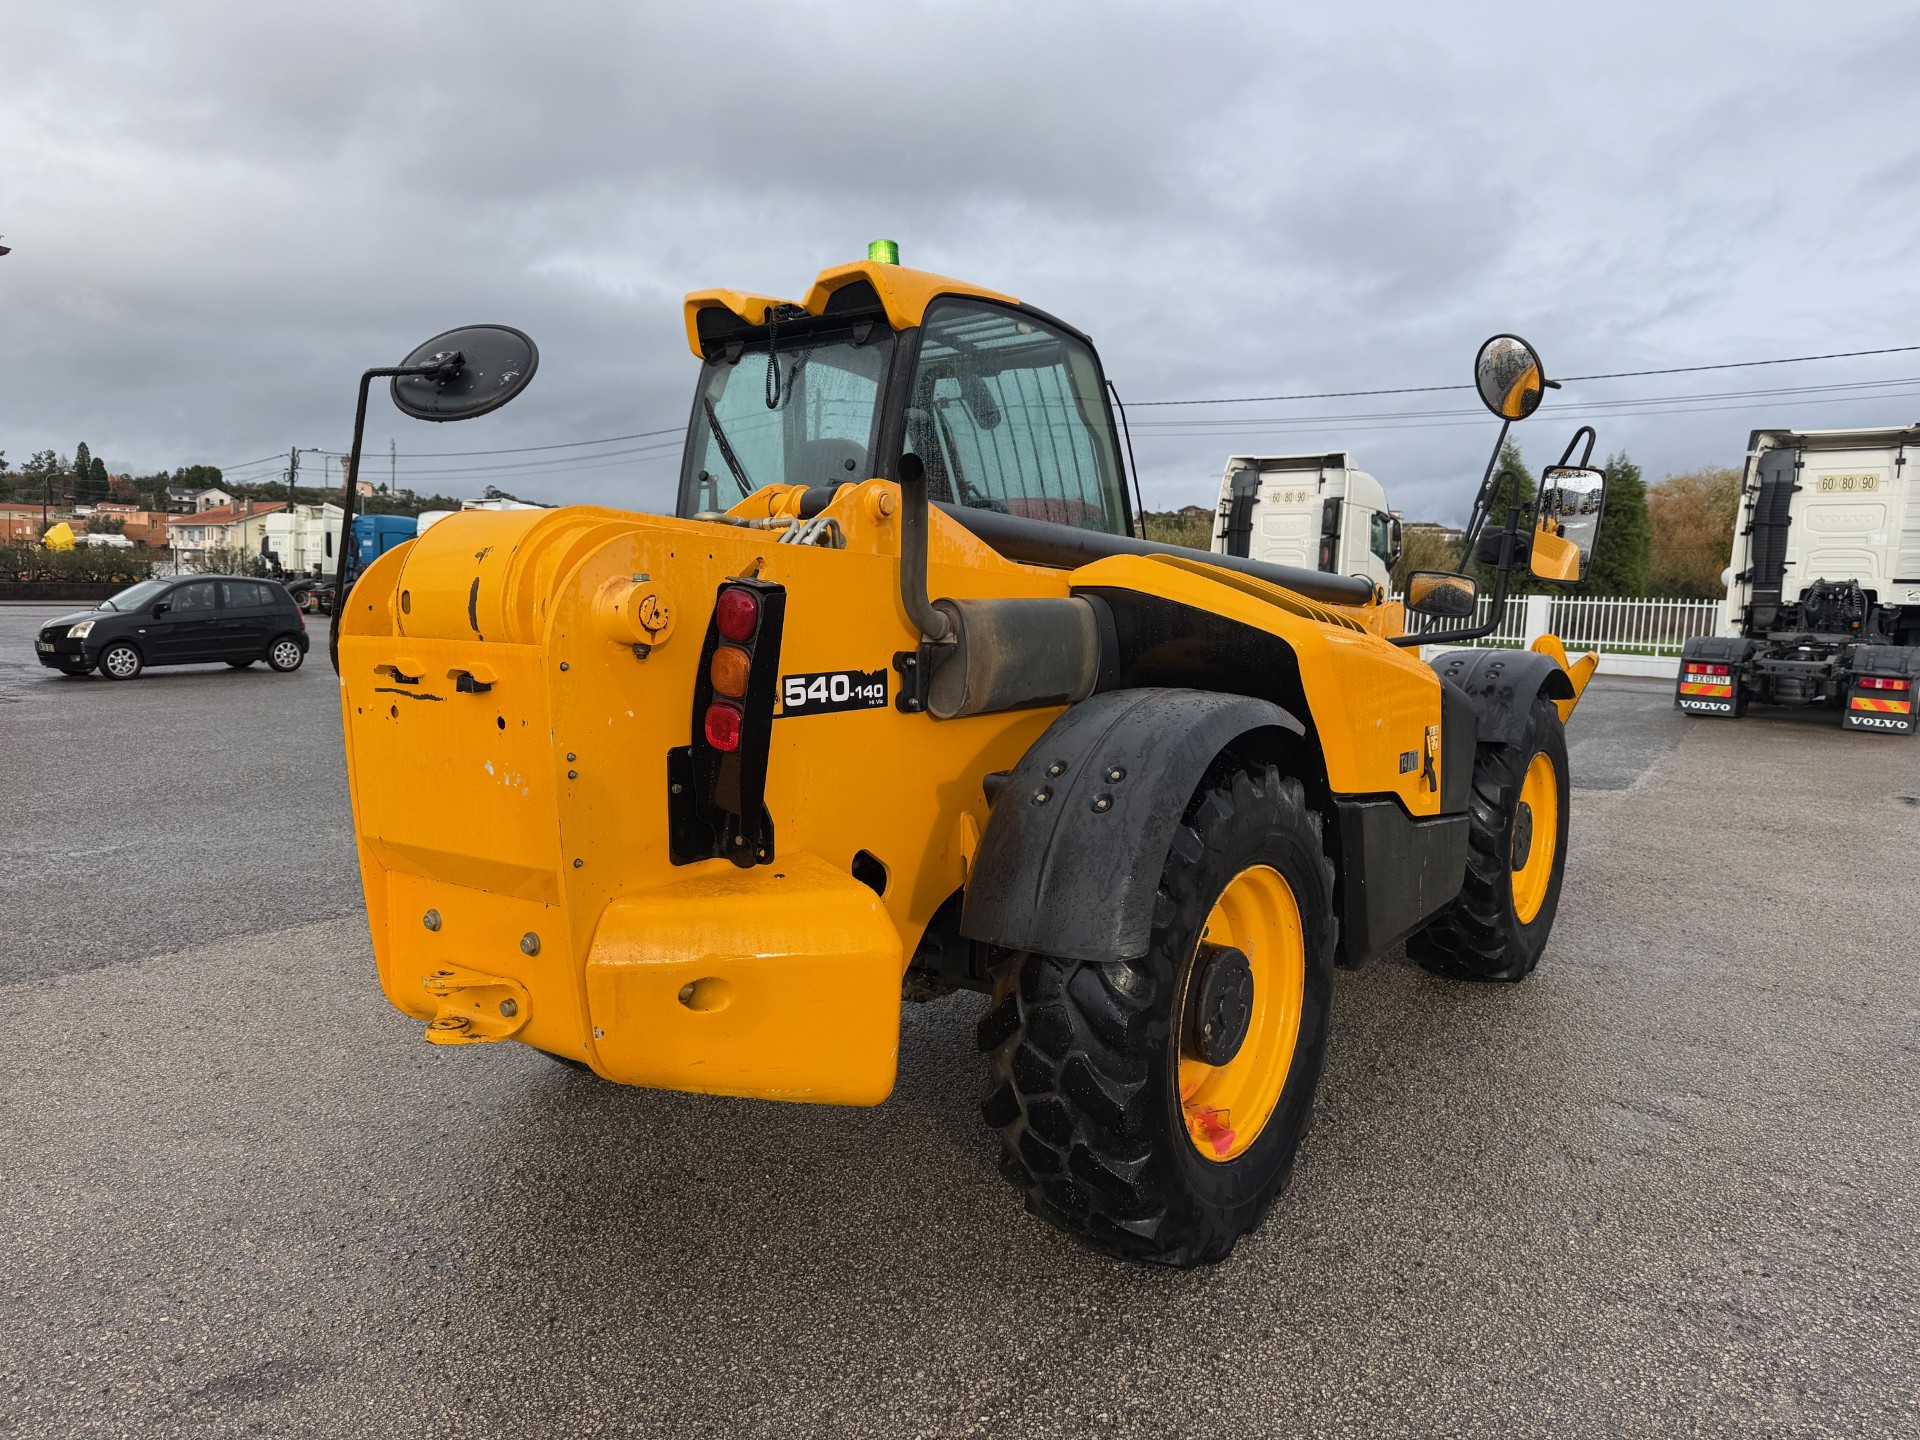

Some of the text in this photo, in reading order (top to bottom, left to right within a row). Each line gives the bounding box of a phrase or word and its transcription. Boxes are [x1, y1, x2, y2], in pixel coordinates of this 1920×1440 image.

[1822, 477, 1874, 490] 60 80 90
[1272, 492, 1280, 503] 60
[1297, 492, 1305, 502] 90
[1815, 514, 1876, 524] VOLVO
[1679, 700, 1731, 711] VOLVO
[1849, 716, 1909, 729] VOLVO
